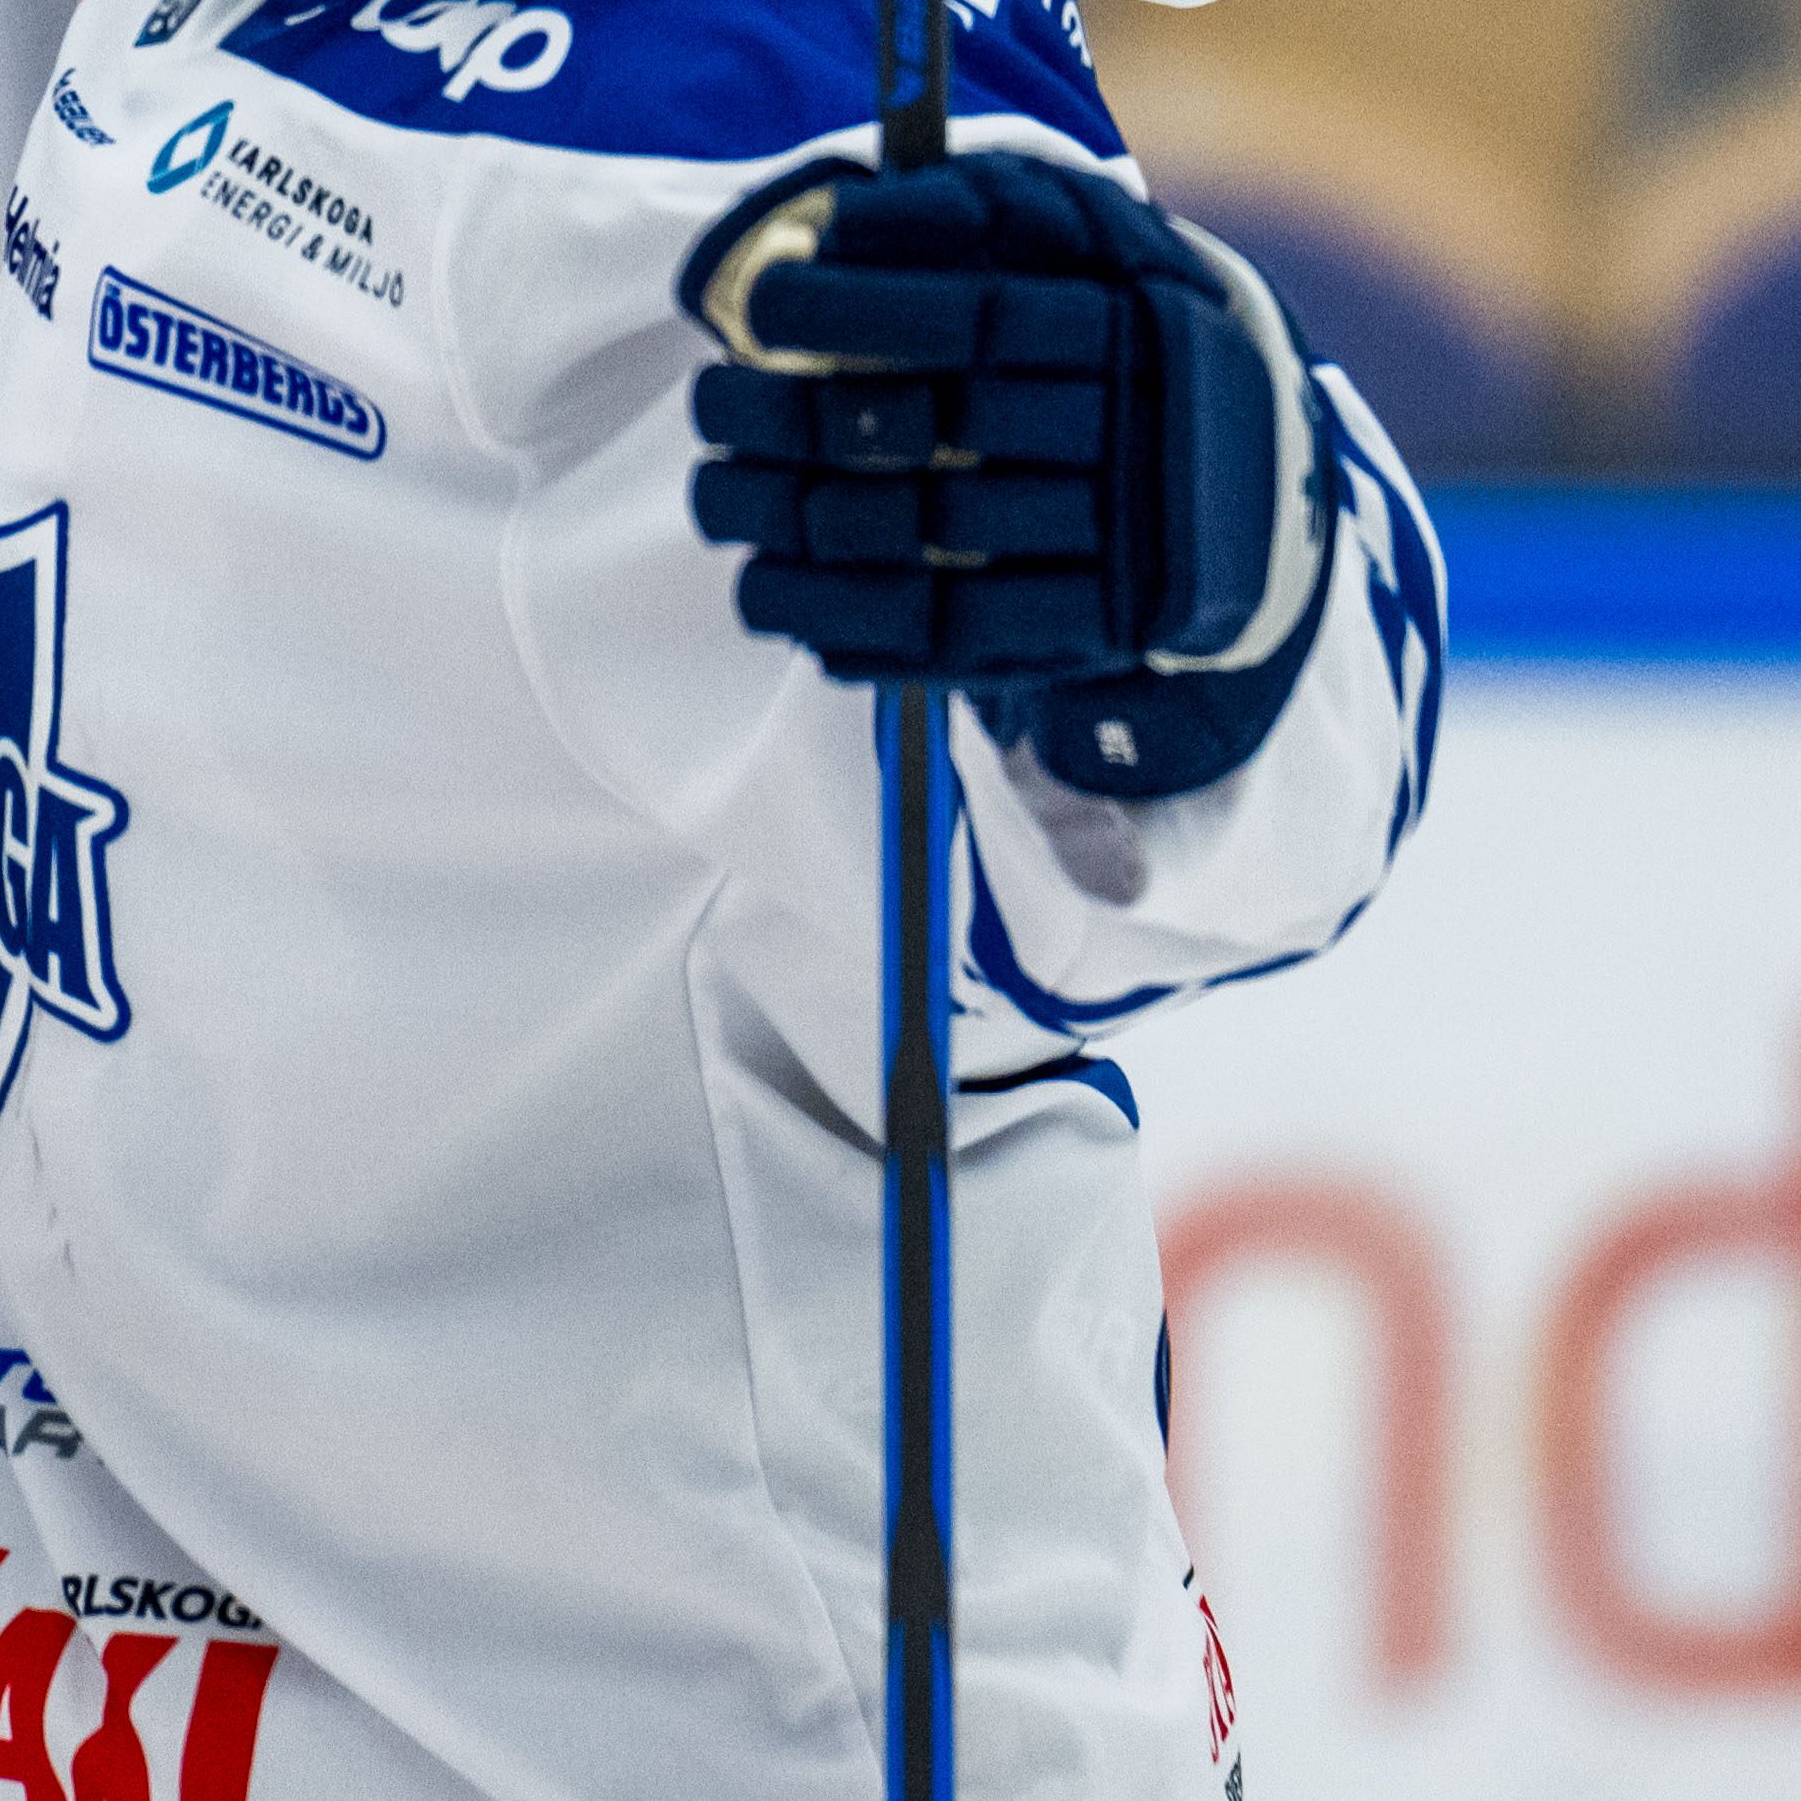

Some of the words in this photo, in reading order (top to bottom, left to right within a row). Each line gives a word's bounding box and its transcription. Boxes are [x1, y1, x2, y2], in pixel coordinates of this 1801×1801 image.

[200, 170, 304, 248] ENERGI
[301, 233, 324, 262] &
[227, 137, 373, 246] KARLSKOGA
[99, 287, 369, 436] ÖSTERBERGS
[62, 1574, 264, 1630] RLSKOG
